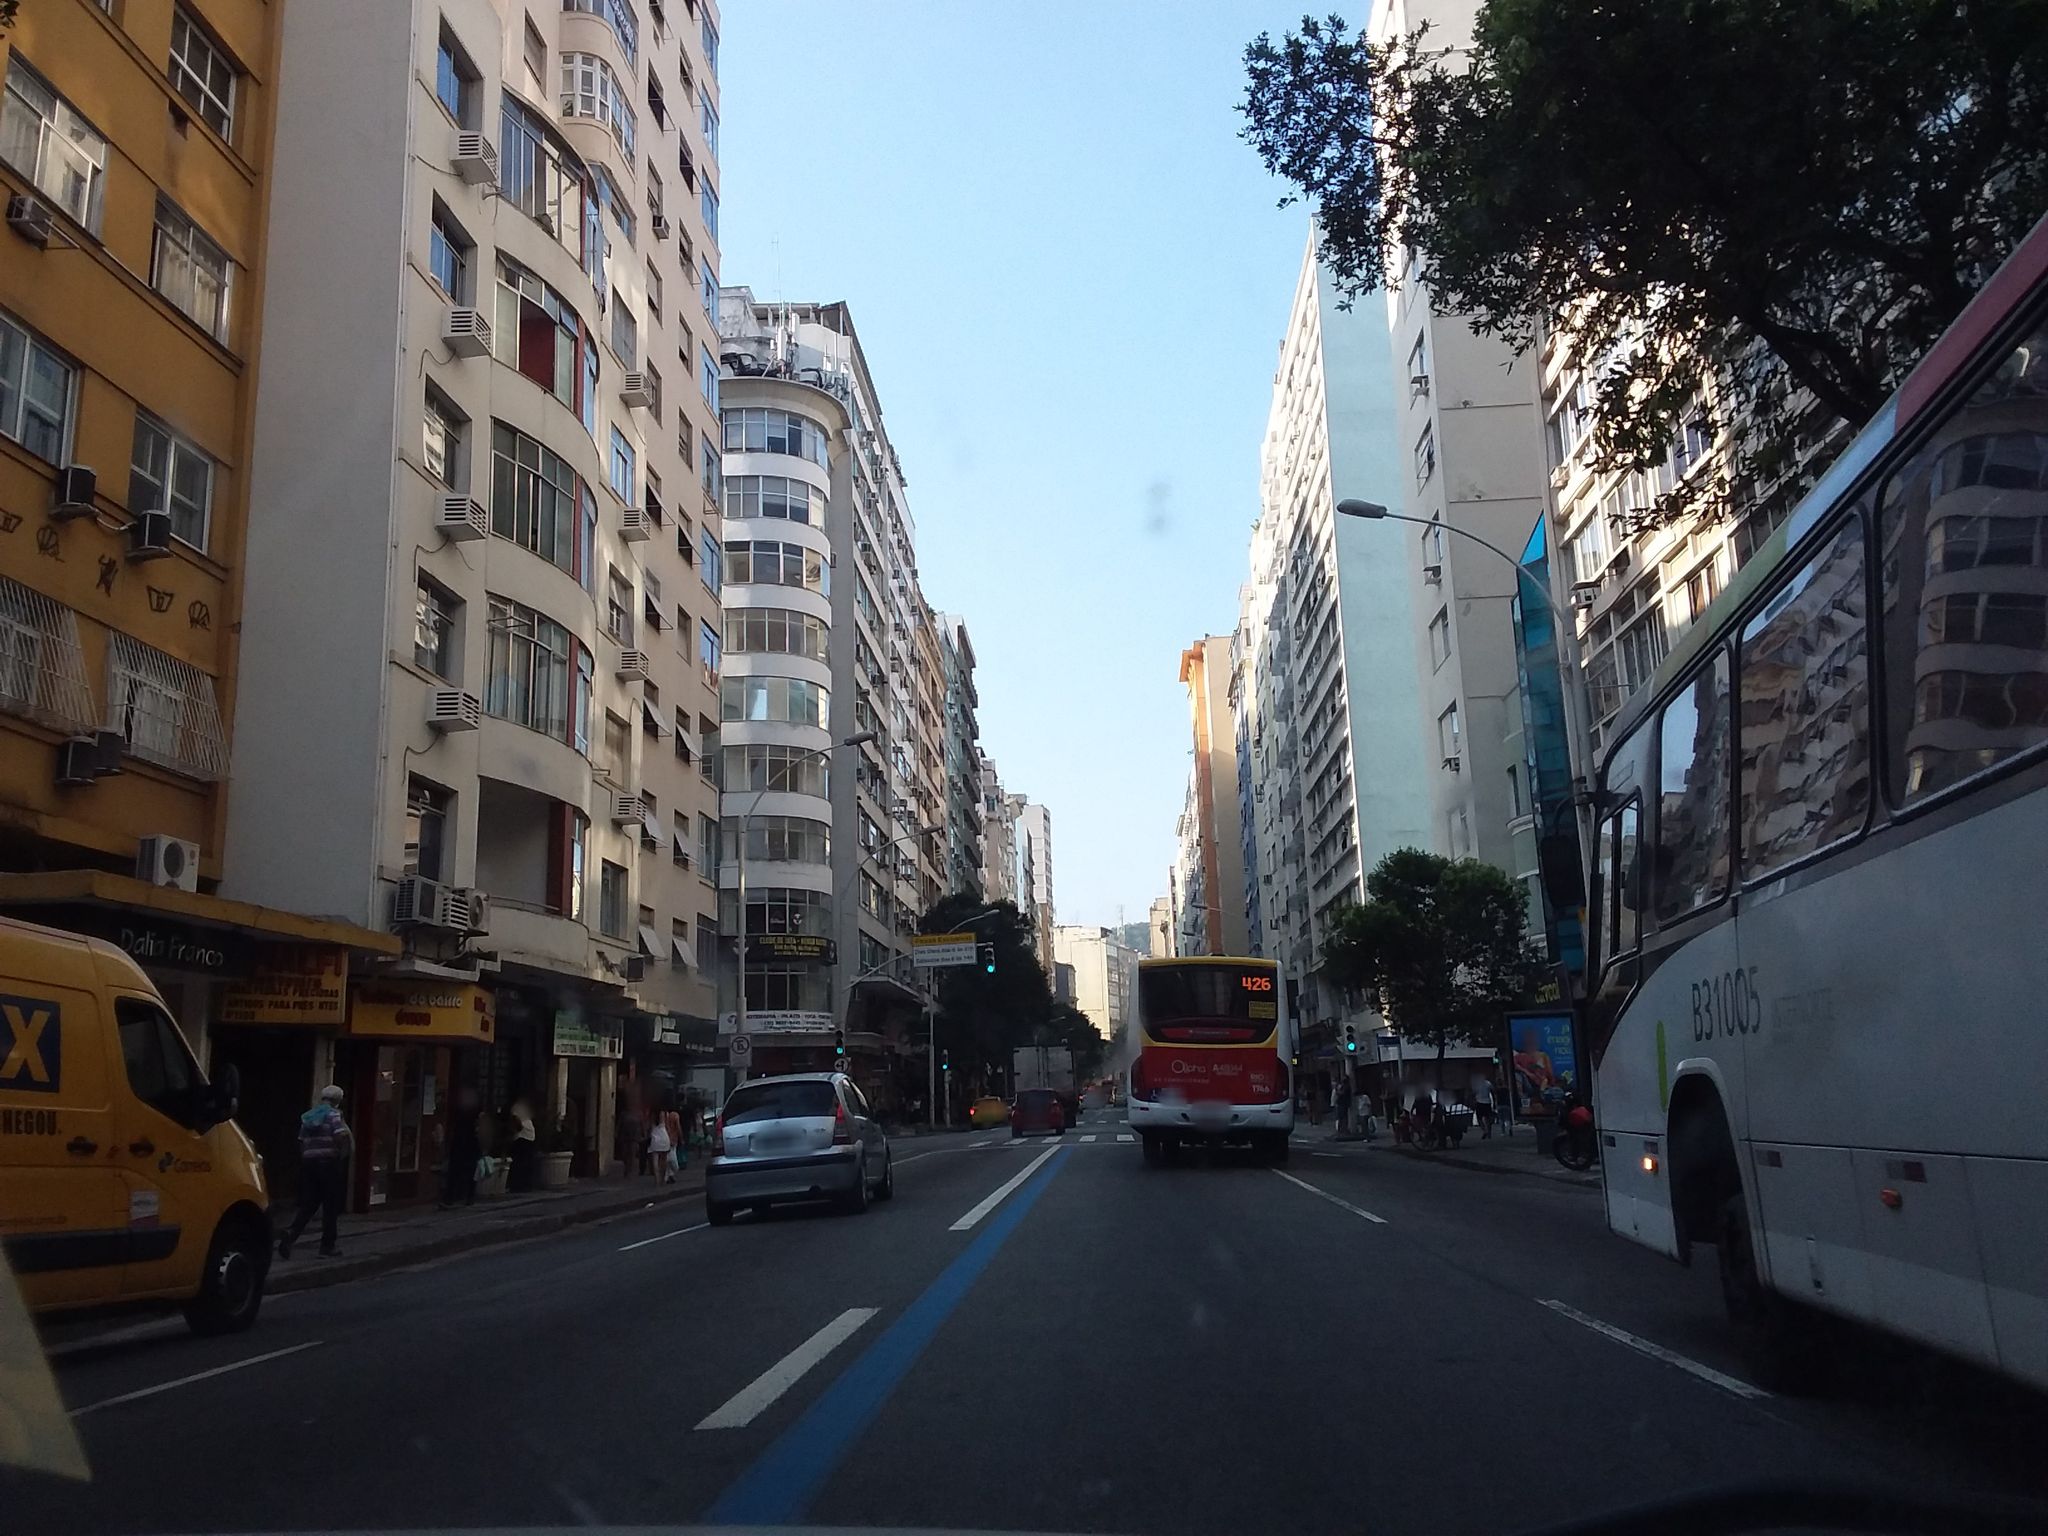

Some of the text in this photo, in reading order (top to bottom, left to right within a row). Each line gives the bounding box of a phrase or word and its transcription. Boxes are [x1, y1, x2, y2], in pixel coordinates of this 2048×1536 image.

[120, 928, 164, 957] Dalia
[168, 934, 224, 967] Franco
[1241, 976, 1271, 991] 426
[267, 1000, 291, 1009] PARA
[409, 992, 426, 1004] do
[1692, 965, 1761, 1042] B31005
